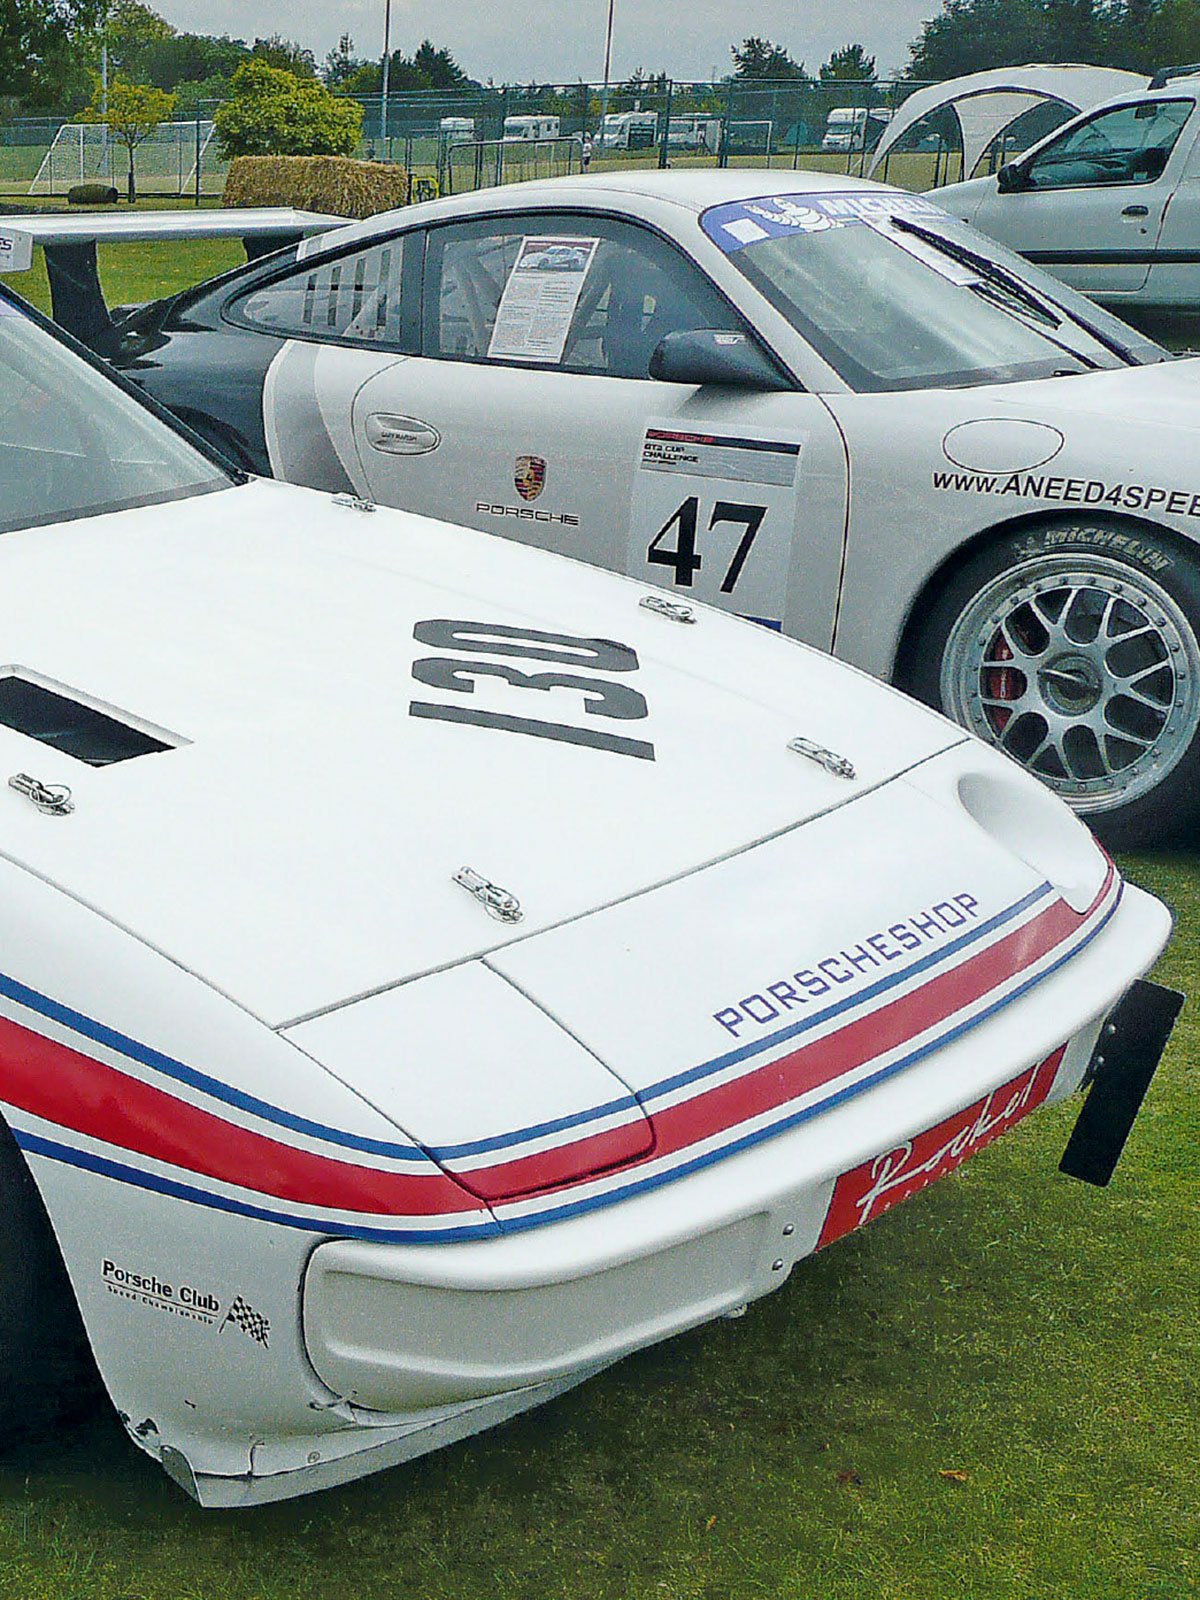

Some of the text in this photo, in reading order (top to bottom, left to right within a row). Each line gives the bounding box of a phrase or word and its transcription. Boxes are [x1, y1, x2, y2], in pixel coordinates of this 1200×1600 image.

[643, 451, 699, 463] CHALLENGE
[476, 503, 579, 526] PORSCHE
[647, 496, 769, 594] 47
[408, 619, 656, 761] 130
[712, 893, 979, 1038] PORSCHESHOP
[102, 1259, 219, 1312] Porsche Club
